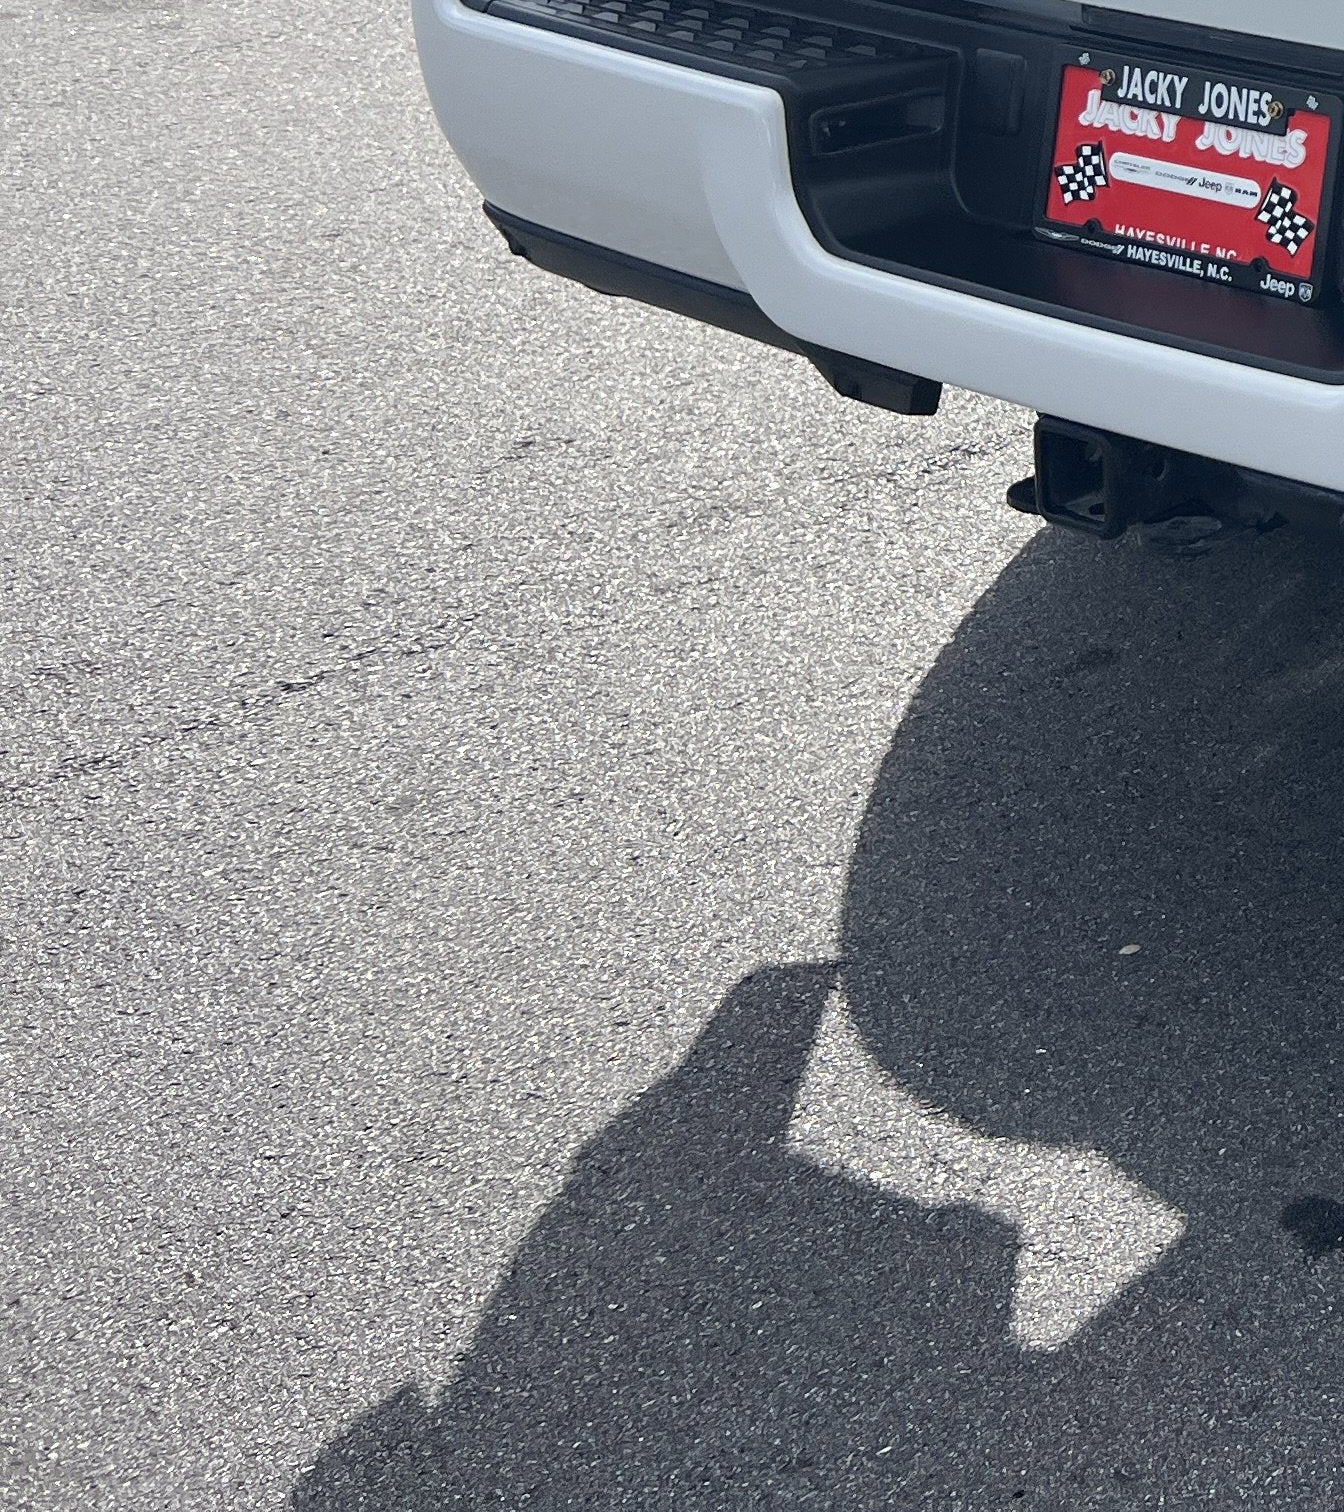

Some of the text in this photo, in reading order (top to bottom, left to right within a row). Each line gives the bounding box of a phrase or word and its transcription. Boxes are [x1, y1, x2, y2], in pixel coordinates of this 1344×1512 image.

[1117, 65, 1273, 126] JACKY JONES
[1078, 89, 1308, 168] JACKY JONES
[1199, 177, 1223, 193] Jeep
[1127, 245, 1233, 282] HAYESVILLE, N.C.
[1260, 273, 1295, 297] Jeep
